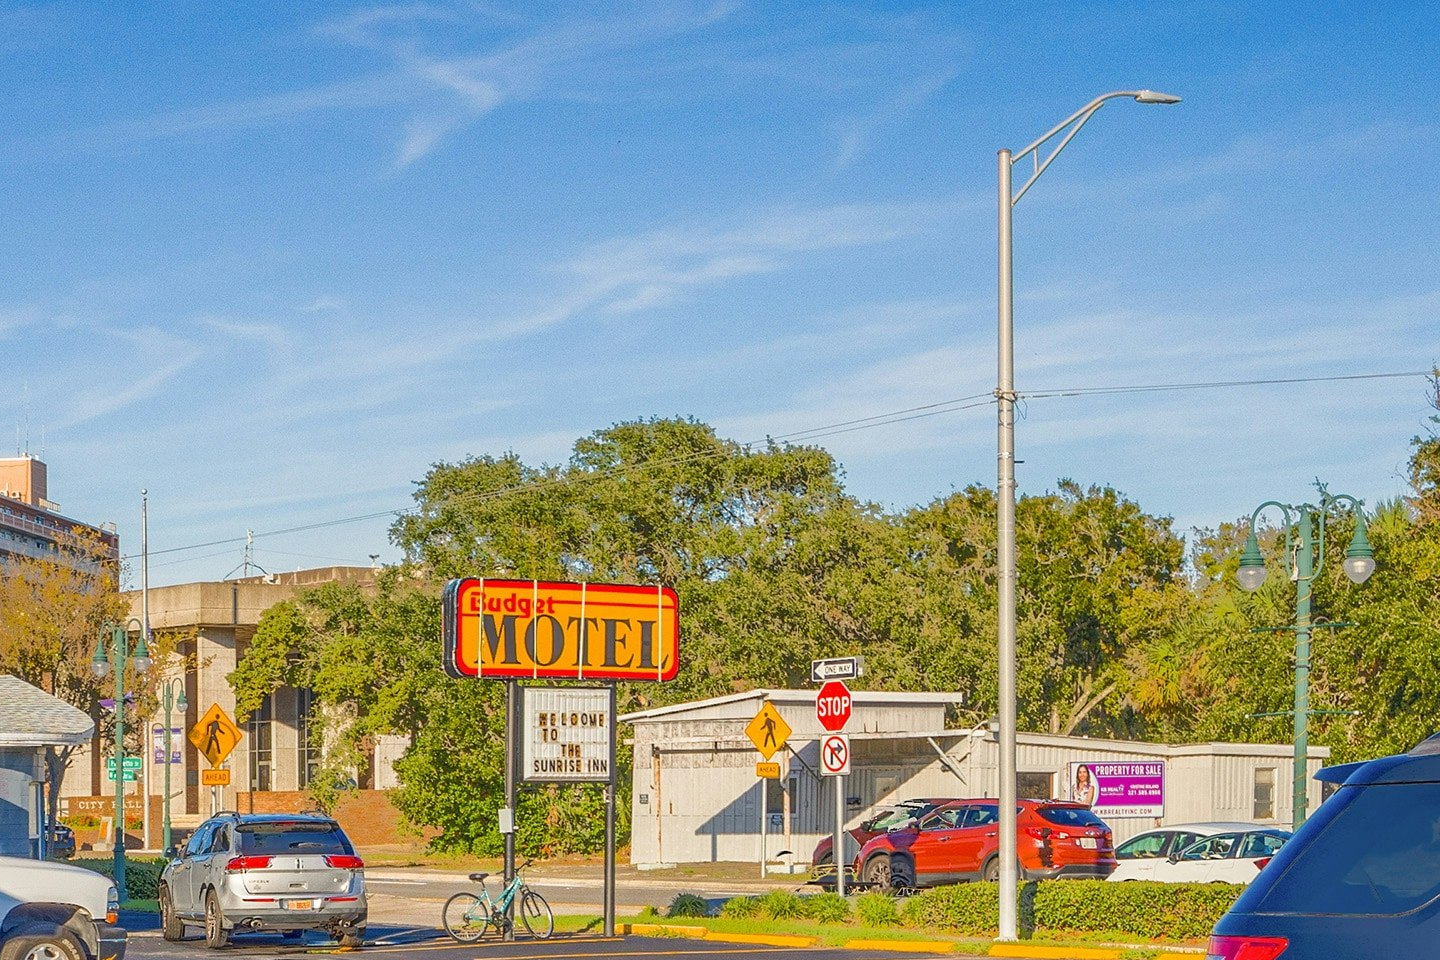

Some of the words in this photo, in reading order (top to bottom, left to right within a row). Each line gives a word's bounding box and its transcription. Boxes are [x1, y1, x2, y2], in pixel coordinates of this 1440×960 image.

[470, 591, 556, 618] Budget
[474, 614, 670, 670] MOTEL
[824, 666, 837, 674] ONE
[838, 664, 851, 672] WAY
[818, 696, 850, 717] STOP
[542, 728, 558, 743] TO
[561, 744, 581, 759] THE
[534, 760, 582, 773] SUNRISE
[588, 759, 607, 773] INN
[1095, 765, 1130, 775] PROPERTY
[1131, 765, 1144, 775] FOR
[1145, 765, 1162, 775] SALE
[205, 773, 227, 782] AHEAD
[78, 801, 105, 809] CITY
